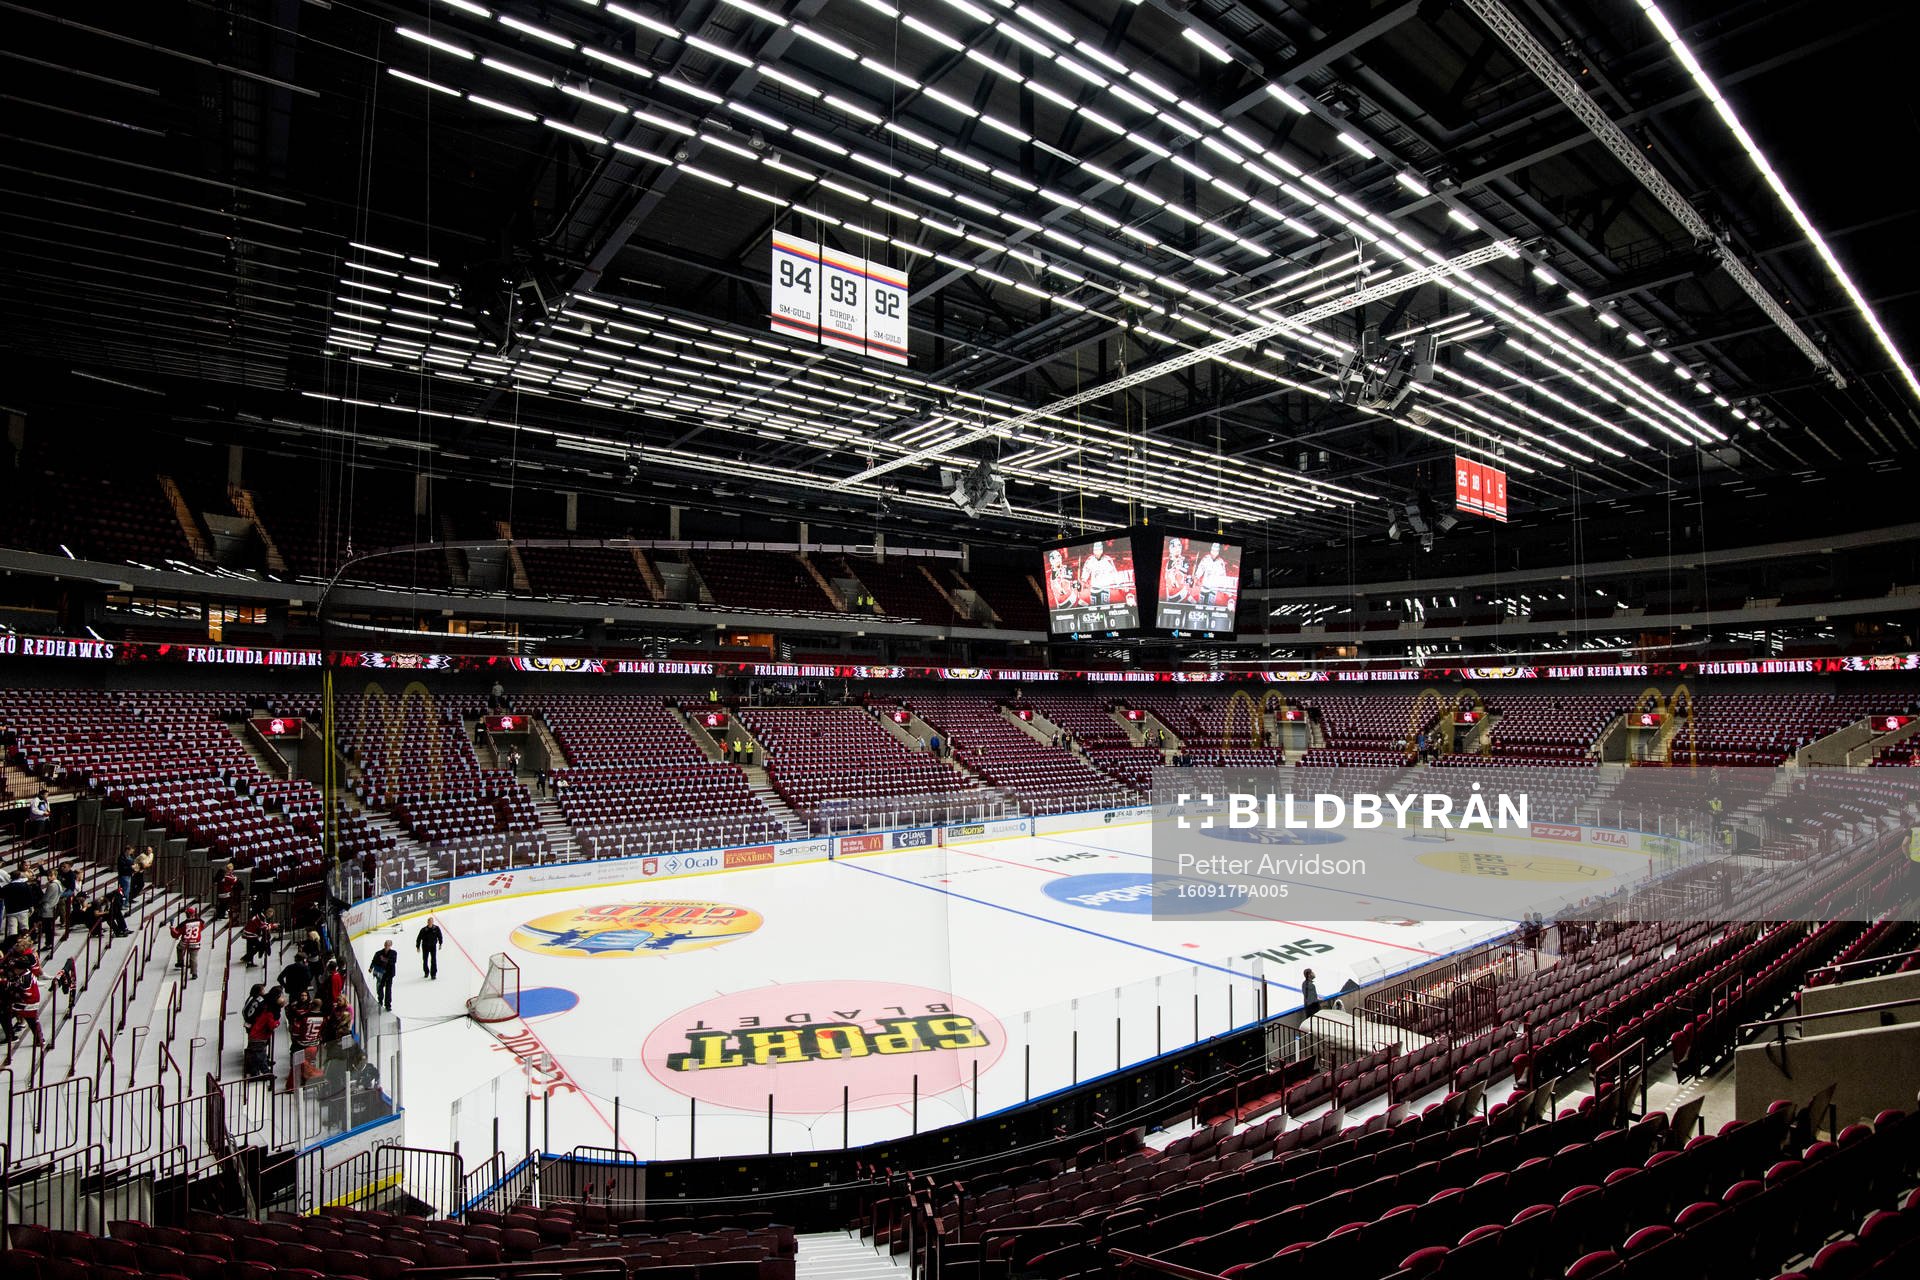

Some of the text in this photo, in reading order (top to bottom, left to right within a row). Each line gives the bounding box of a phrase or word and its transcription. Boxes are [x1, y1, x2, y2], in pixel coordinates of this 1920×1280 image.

[780, 259, 812, 294] 94
[830, 275, 857, 307] 93
[875, 288, 900, 320] 92
[23, 638, 114, 659] REDHAWKS
[187, 647, 322, 666] FRÖLUNDA INDIANS
[618, 661, 713, 675] MALMÖ REDHAWKS
[754, 664, 835, 677] FRÖLUNDA INDIANS
[1549, 665, 1648, 677] MALMÖ REDHAWKS
[1699, 659, 1813, 675] FRÖLUNDA INDIANS
[1022, 671, 1059, 681] REDHAWKS
[1087, 672, 1155, 682] FRÖLUNDA INDIANS
[1371, 670, 1420, 681] REDHAWKS
[1592, 831, 1627, 845] JULA
[685, 856, 718, 869] Ocab
[462, 887, 503, 900] Holmbergs
[584, 904, 749, 919] GULD
[184, 927, 199, 939] 33
[1242, 938, 1335, 966] SHL
[686, 1002, 951, 1033] BLADET
[306, 1023, 321, 1037] 15
[666, 1014, 990, 1072] SPORT
